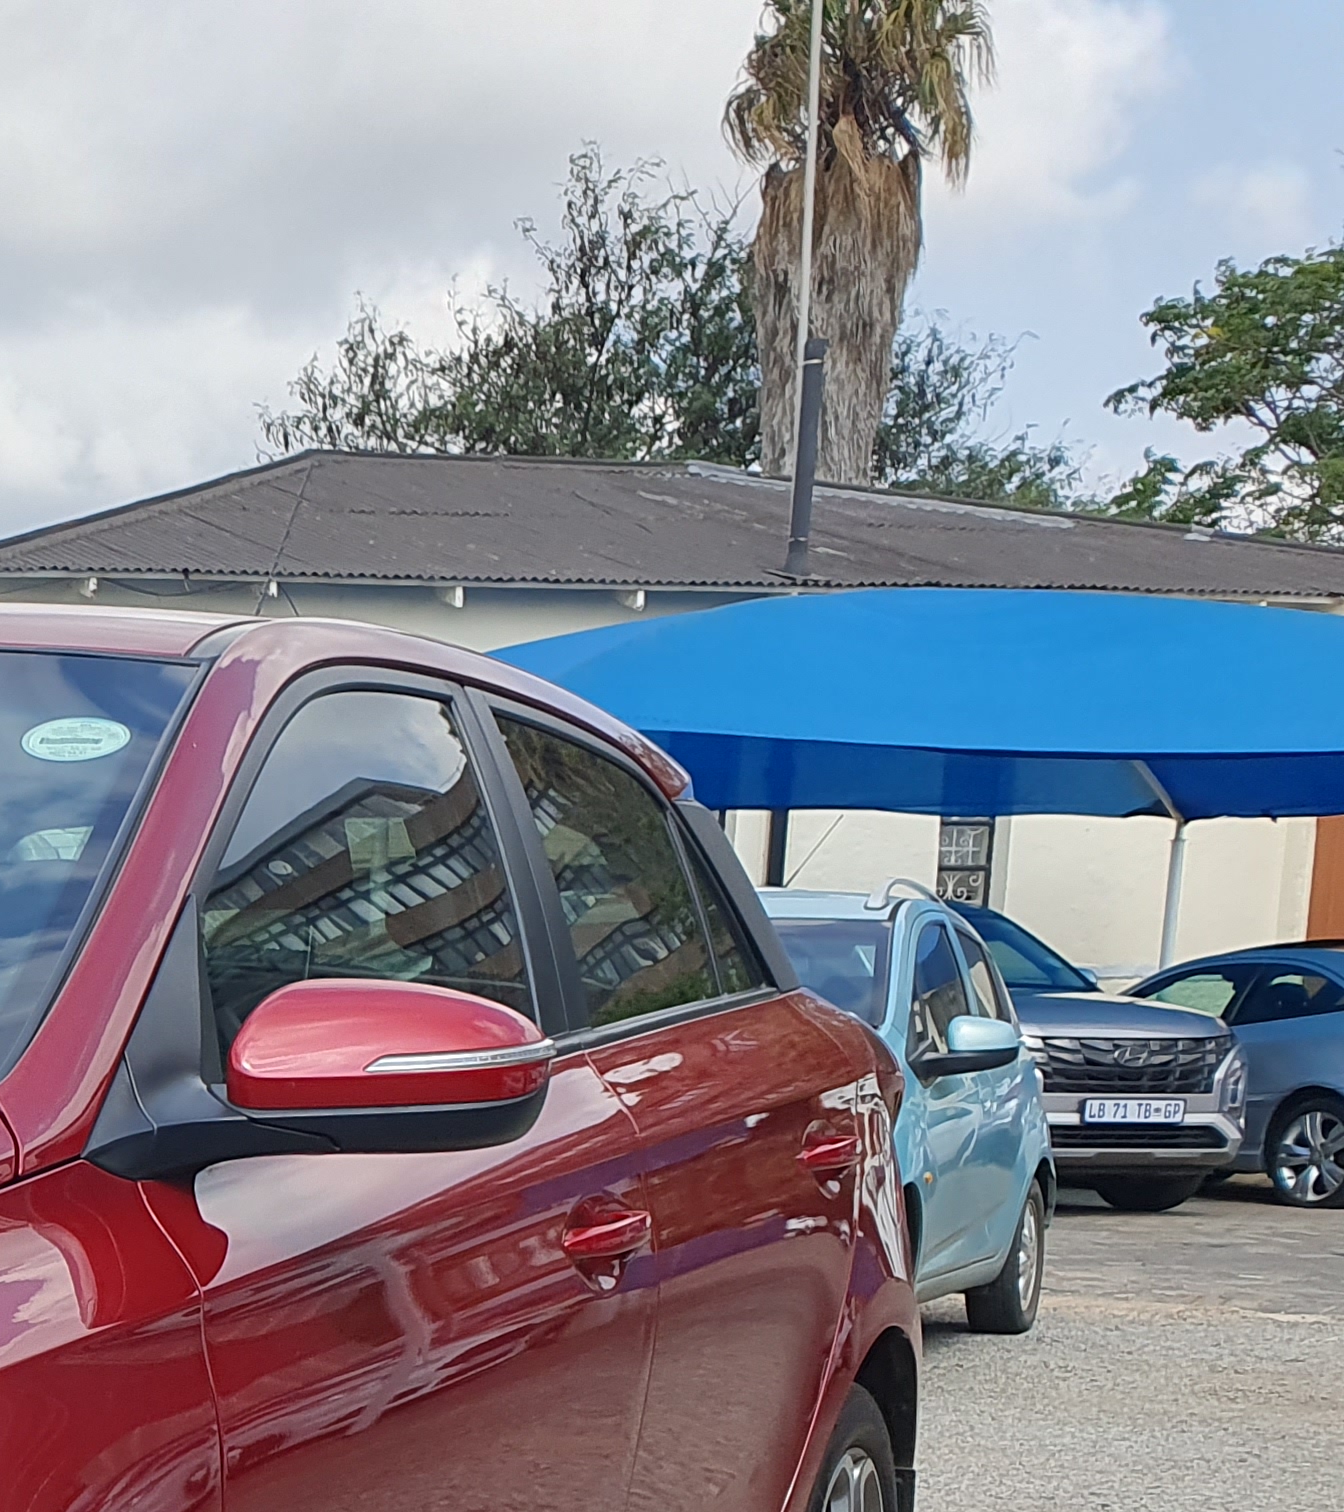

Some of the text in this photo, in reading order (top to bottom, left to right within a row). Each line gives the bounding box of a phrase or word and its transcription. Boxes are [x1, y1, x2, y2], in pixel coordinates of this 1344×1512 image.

[1088, 1102, 1181, 1119] LB 71 TB GP
